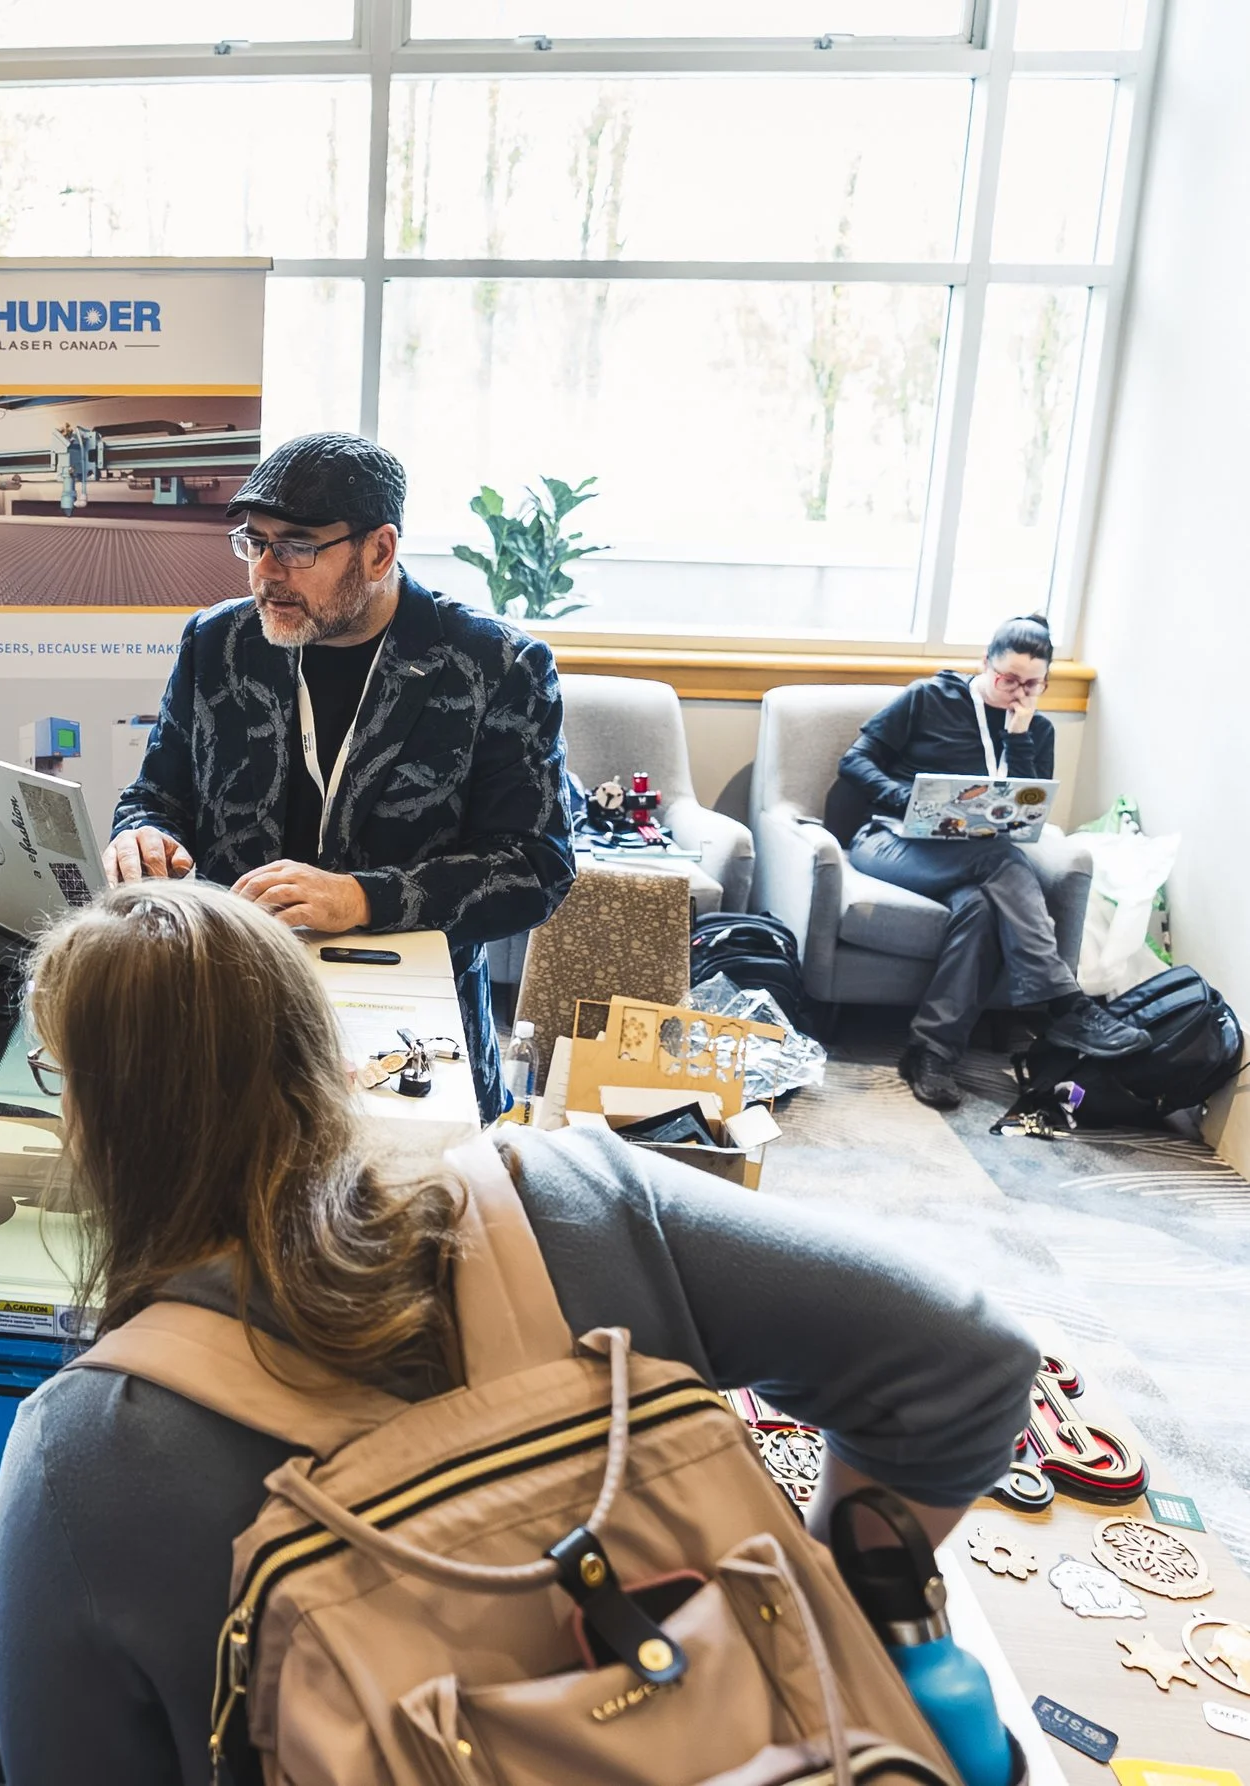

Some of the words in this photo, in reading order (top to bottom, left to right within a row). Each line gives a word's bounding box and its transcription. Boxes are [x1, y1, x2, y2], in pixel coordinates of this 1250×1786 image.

[59, 340, 118, 351] CANADA
[38, 643, 97, 654] BECAUSE
[101, 643, 143, 654] WE'RE
[12, 1304, 49, 1314] CAUTION
